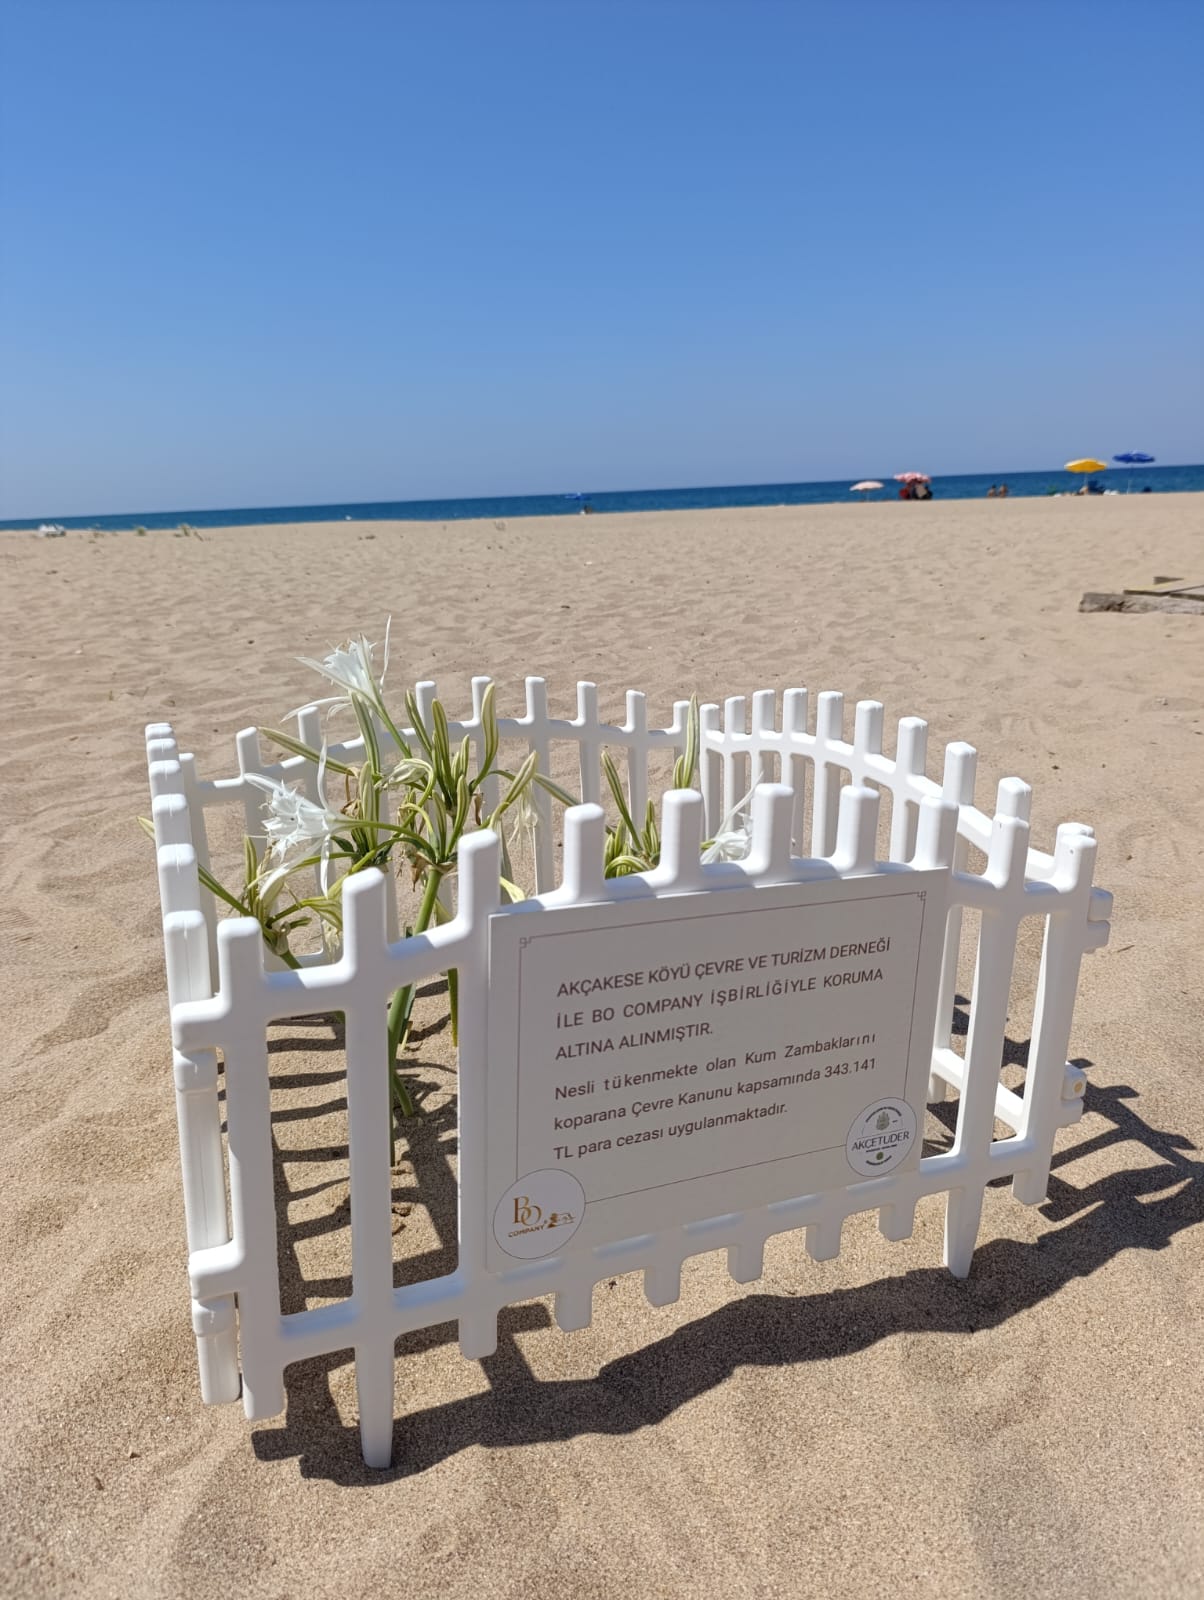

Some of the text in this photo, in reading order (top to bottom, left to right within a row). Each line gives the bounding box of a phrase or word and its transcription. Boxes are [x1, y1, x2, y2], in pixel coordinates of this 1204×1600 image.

[557, 937, 891, 997] AKÇAKESE KÖYÜ ÇEVRE VE TURİZM DERNEĞİ
[557, 968, 883, 1029] İLE BO COMPANY İŞBİRLİĞİYLE KORUMA
[555, 1022, 713, 1060] ALTINA ALINMIŞTIR.
[555, 1034, 875, 1100] Nesli tükenmekte olan Kum Zambaklarını
[554, 1058, 876, 1130] koparana Çevre Kanunu kapsamında 343.141
[553, 1102, 787, 1160] TL para cezası uygulanmaktadır.
[513, 1196, 542, 1226] BO
